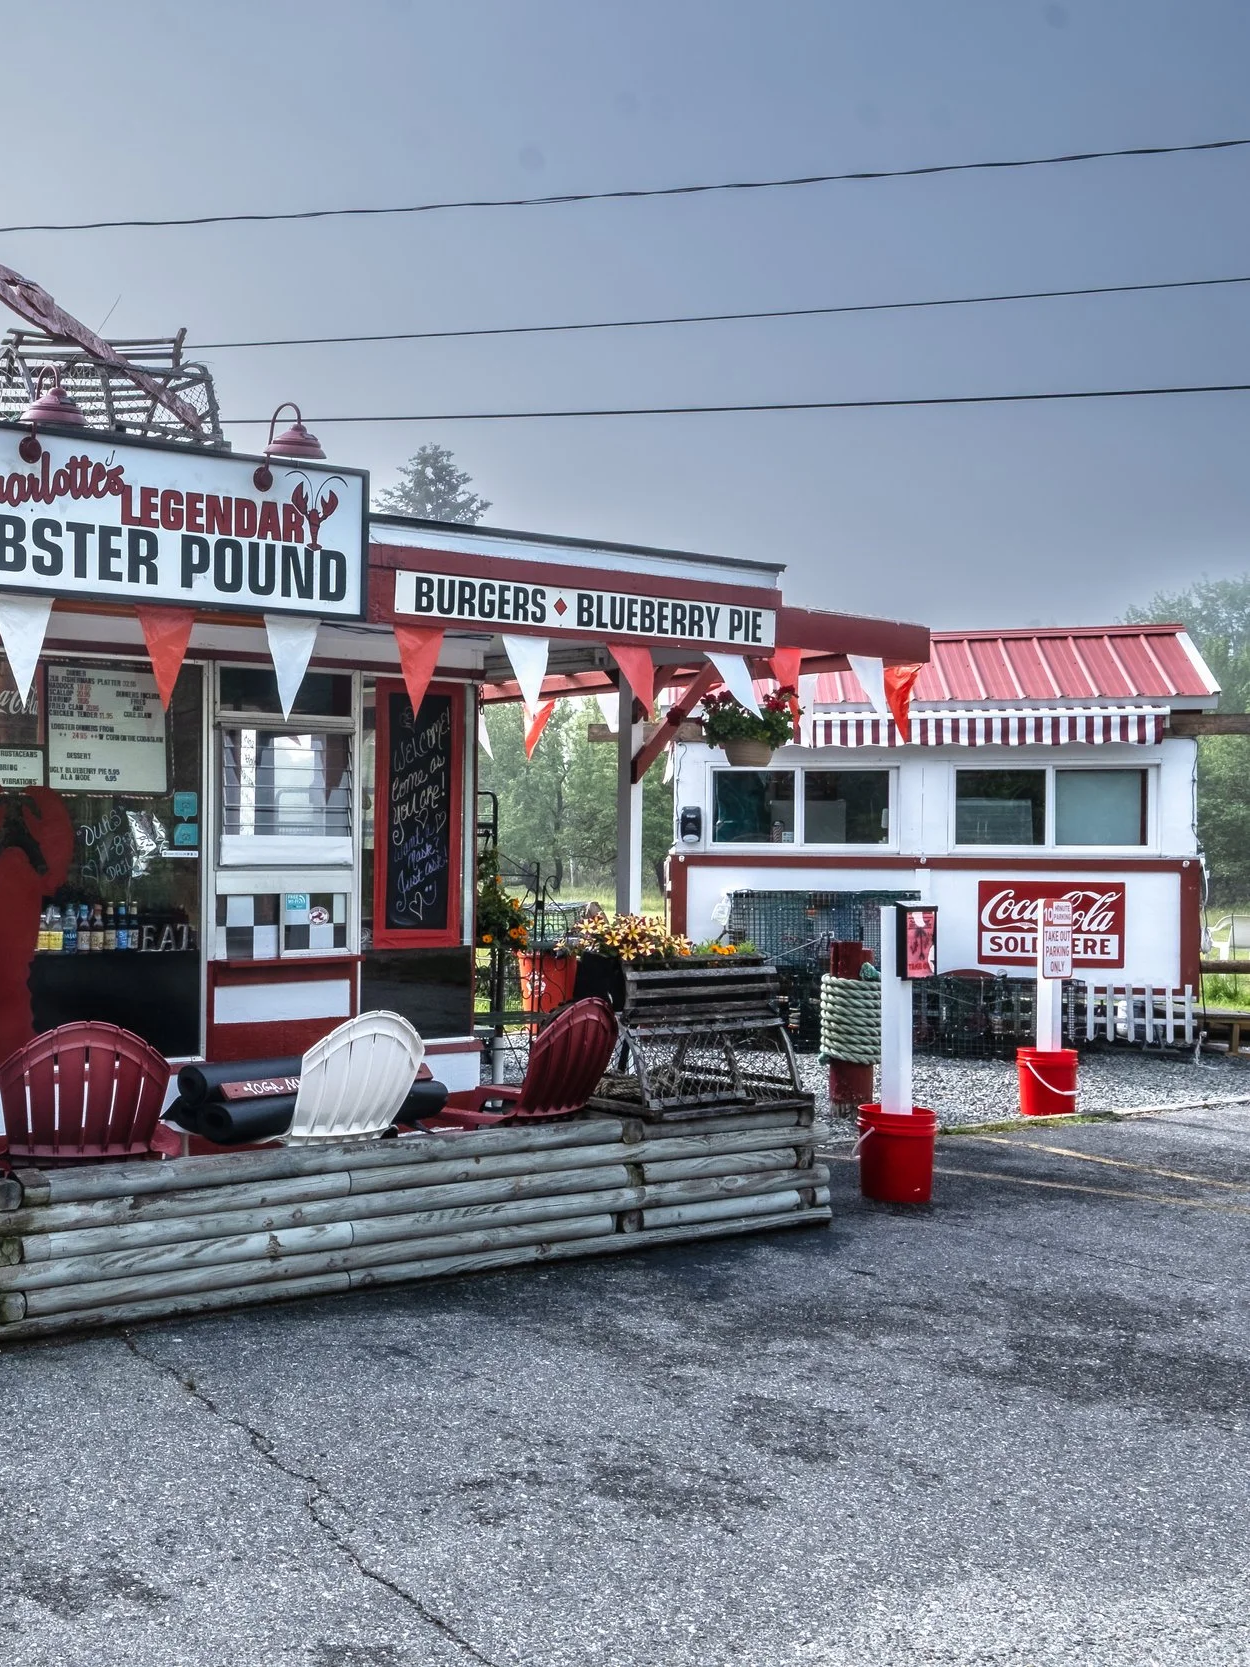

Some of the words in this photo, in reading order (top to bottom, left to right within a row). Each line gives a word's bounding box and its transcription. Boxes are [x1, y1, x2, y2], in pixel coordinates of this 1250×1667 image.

[181, 534, 347, 602] POUND
[415, 576, 546, 623] BURGERS
[576, 594, 720, 638] BLUEBERRY
[729, 609, 762, 643] PIE
[65, 767, 96, 775] BLUEBERRY
[1044, 908, 1053, 921] 10
[140, 922, 195, 952] EAT
[1045, 931, 1059, 941] TAKE
[1060, 931, 1070, 941] OUT
[1046, 946, 1069, 956] PARKING
[1051, 961, 1065, 972] ONLY
[243, 1079, 285, 1095] YOGA
